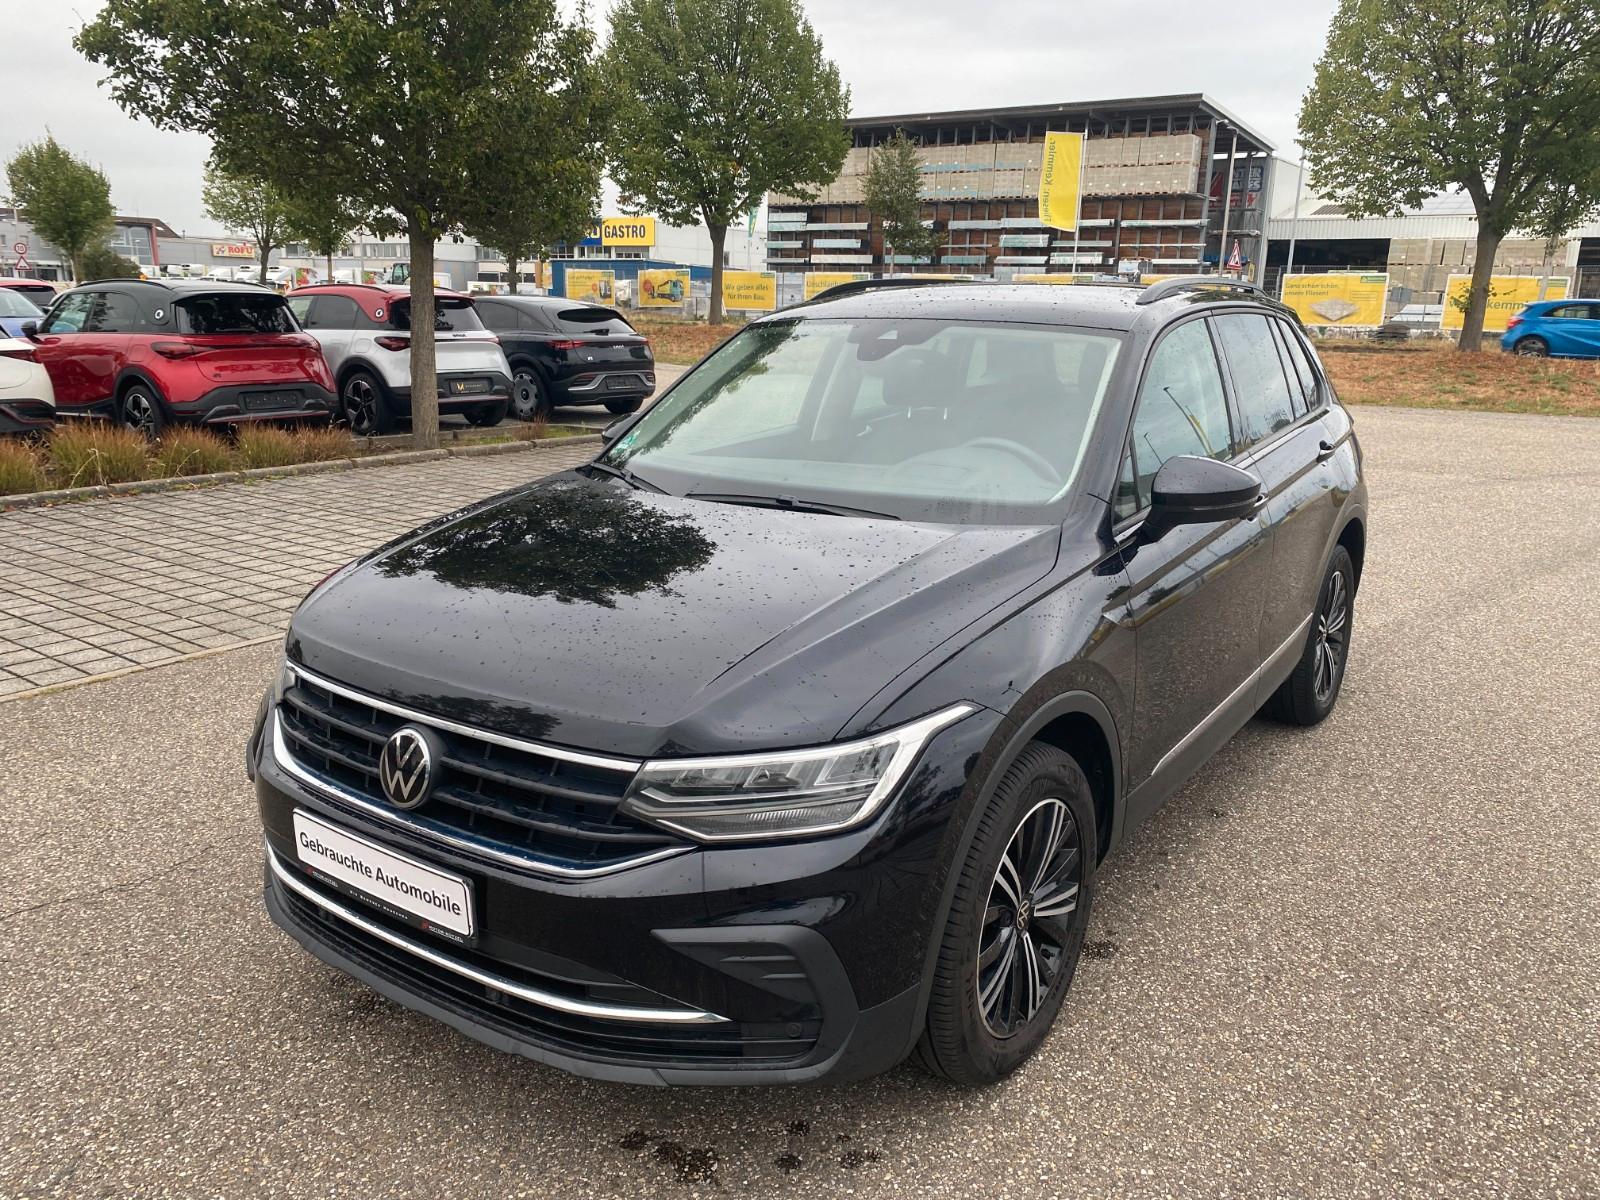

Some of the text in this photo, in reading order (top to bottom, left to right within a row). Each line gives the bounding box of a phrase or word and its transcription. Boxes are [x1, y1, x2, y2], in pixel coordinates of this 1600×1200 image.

[604, 225, 646, 239] GASTRO
[300, 831, 372, 879] Gebrauchte
[375, 867, 461, 916] Automobile
